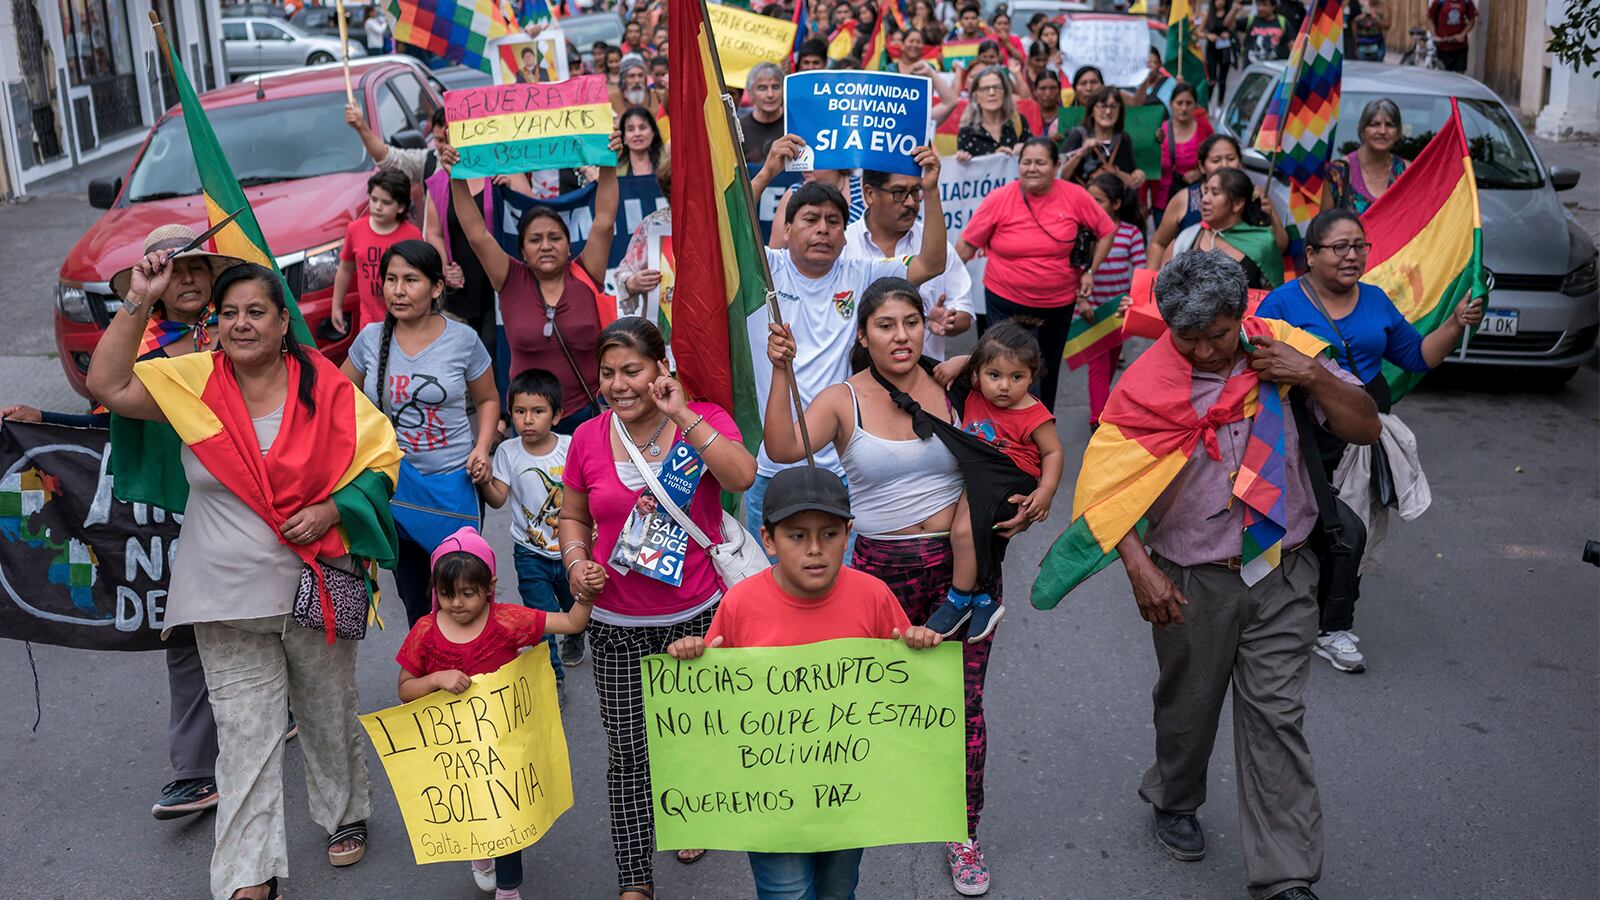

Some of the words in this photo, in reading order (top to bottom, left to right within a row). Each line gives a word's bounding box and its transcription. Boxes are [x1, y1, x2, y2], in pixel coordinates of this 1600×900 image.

[813, 83, 831, 95] LA
[835, 83, 920, 101] COMUNIDAD
[828, 99, 907, 115] BOLIVIANA
[462, 120, 499, 140] LOS
[841, 115, 859, 127] LE
[863, 116, 896, 129] DIJO
[494, 140, 583, 164] BOLIVIA
[815, 129, 838, 151] SI
[843, 130, 863, 150] A
[870, 131, 917, 156] EVO
[665, 472, 693, 489] JUNTOS
[650, 532, 688, 556] DICE
[658, 555, 684, 580] SI
[646, 657, 753, 697] POLICIAS
[766, 656, 910, 695] CORRUPTOS
[376, 676, 532, 757] LIBERTAD
[655, 707, 691, 738] NO
[704, 709, 729, 737] AL
[740, 707, 820, 736] GOLPE
[827, 702, 862, 733] DE
[867, 701, 956, 729] ESTADO
[433, 745, 506, 780] PARA
[738, 734, 871, 769] BOLIVIANO
[421, 762, 544, 824] BOLIVIA
[660, 787, 794, 823] QUEREMOS
[812, 783, 861, 809] PAZ
[421, 823, 538, 857] Salta-Argentina
